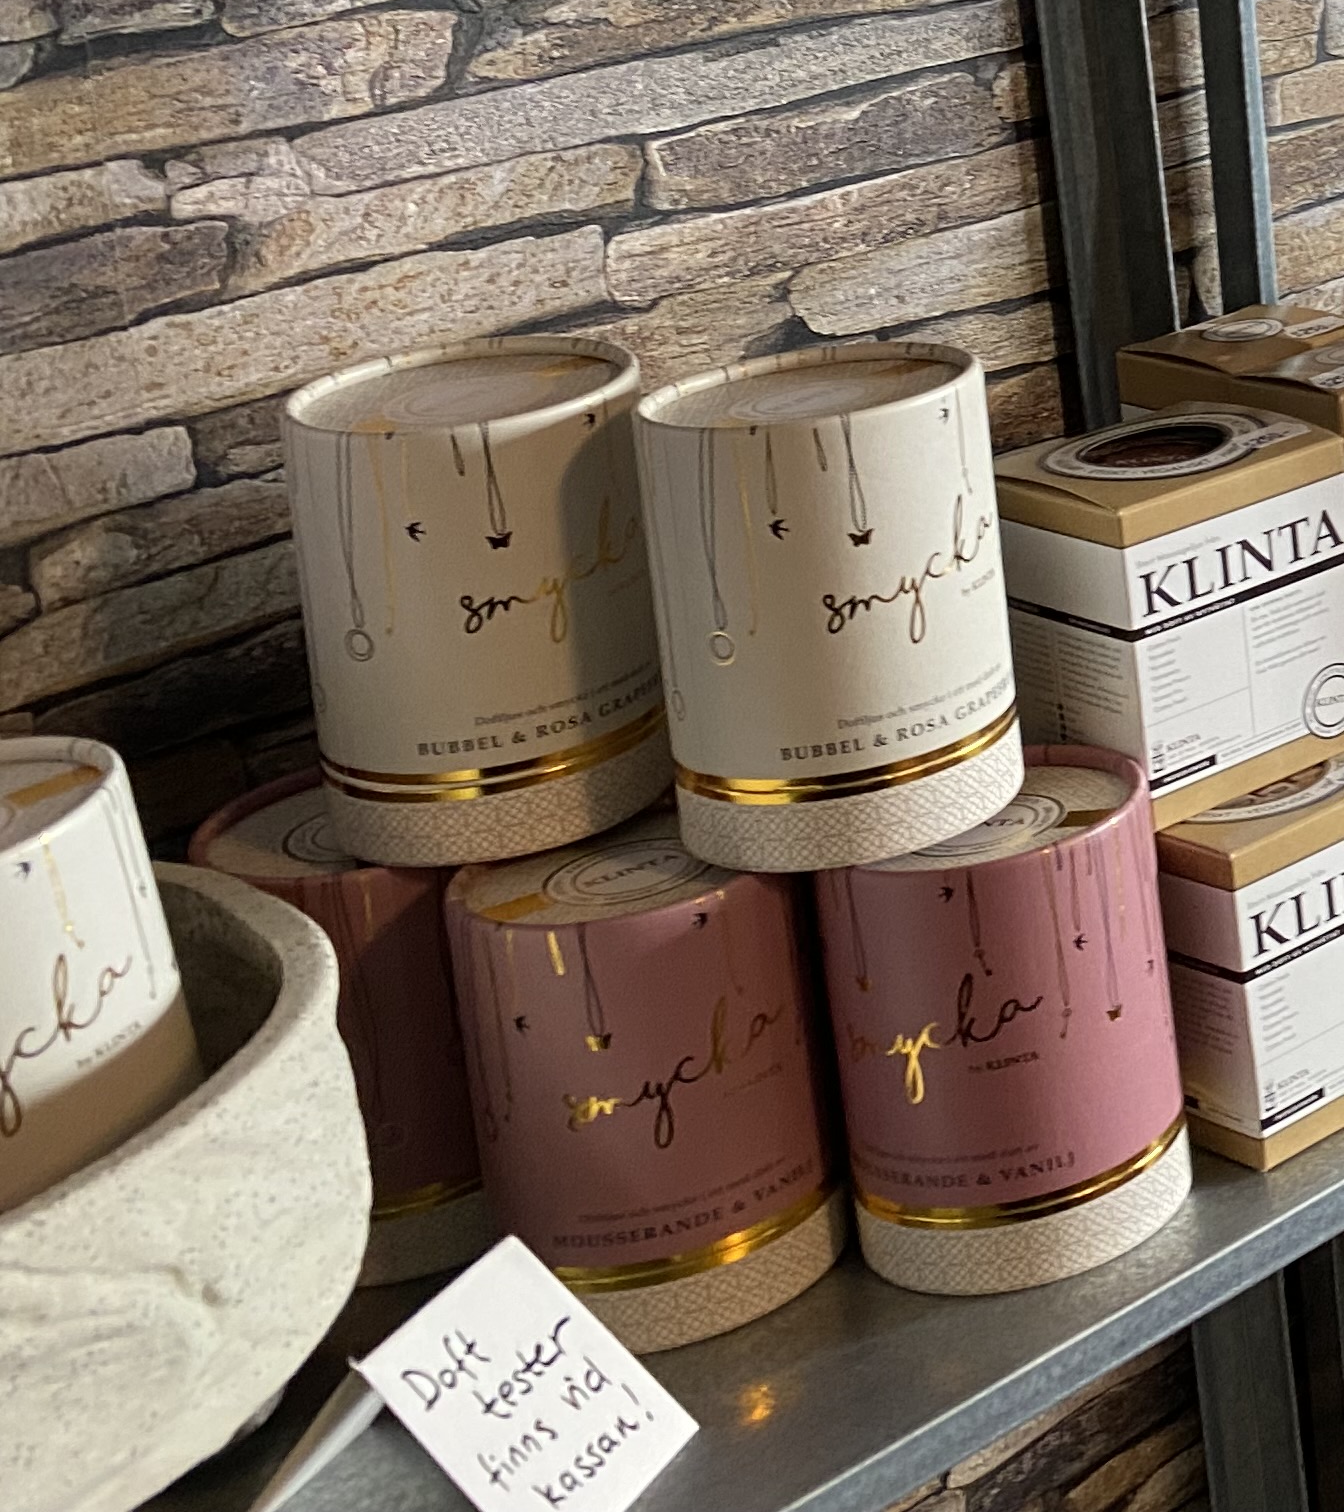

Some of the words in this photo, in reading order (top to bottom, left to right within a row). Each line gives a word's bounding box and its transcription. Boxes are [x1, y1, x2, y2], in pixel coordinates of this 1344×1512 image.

[822, 493, 993, 644] smycka
[417, 735, 504, 756] BUBBEL
[512, 731, 527, 745] &
[536, 710, 593, 738] ROSA
[780, 737, 865, 762] BUBBEL
[873, 733, 888, 749] &
[896, 715, 950, 742] ROSA
[583, 854, 680, 888] KLINTA
[976, 1173, 992, 1186] &
[999, 1151, 1076, 1183] VANILJ
[732, 1200, 746, 1213] &
[400, 1329, 491, 1412] Doft
[472, 1315, 571, 1419] tester
[477, 1418, 559, 1492] finns
[561, 1355, 613, 1411] vid
[531, 1383, 654, 1509] kassan!
